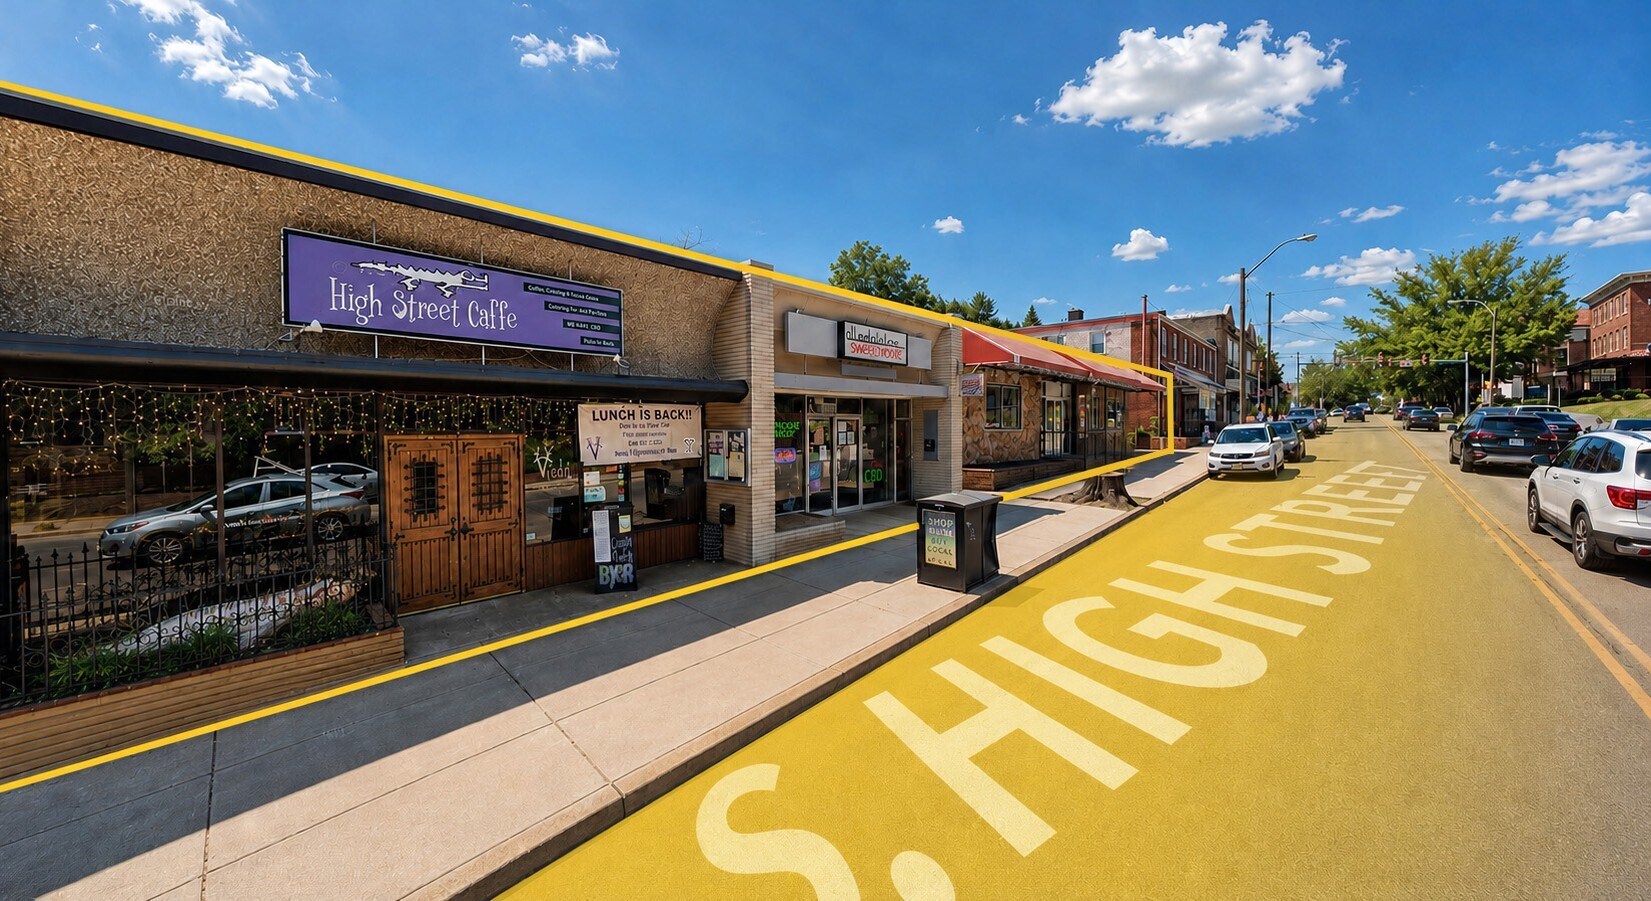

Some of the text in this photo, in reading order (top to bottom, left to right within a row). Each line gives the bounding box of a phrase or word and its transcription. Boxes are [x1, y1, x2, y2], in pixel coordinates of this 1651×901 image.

[329, 276, 517, 331] High Street Caffe
[592, 409, 692, 421] LUNCH IS BACK!!
[864, 469, 883, 482] CBD
